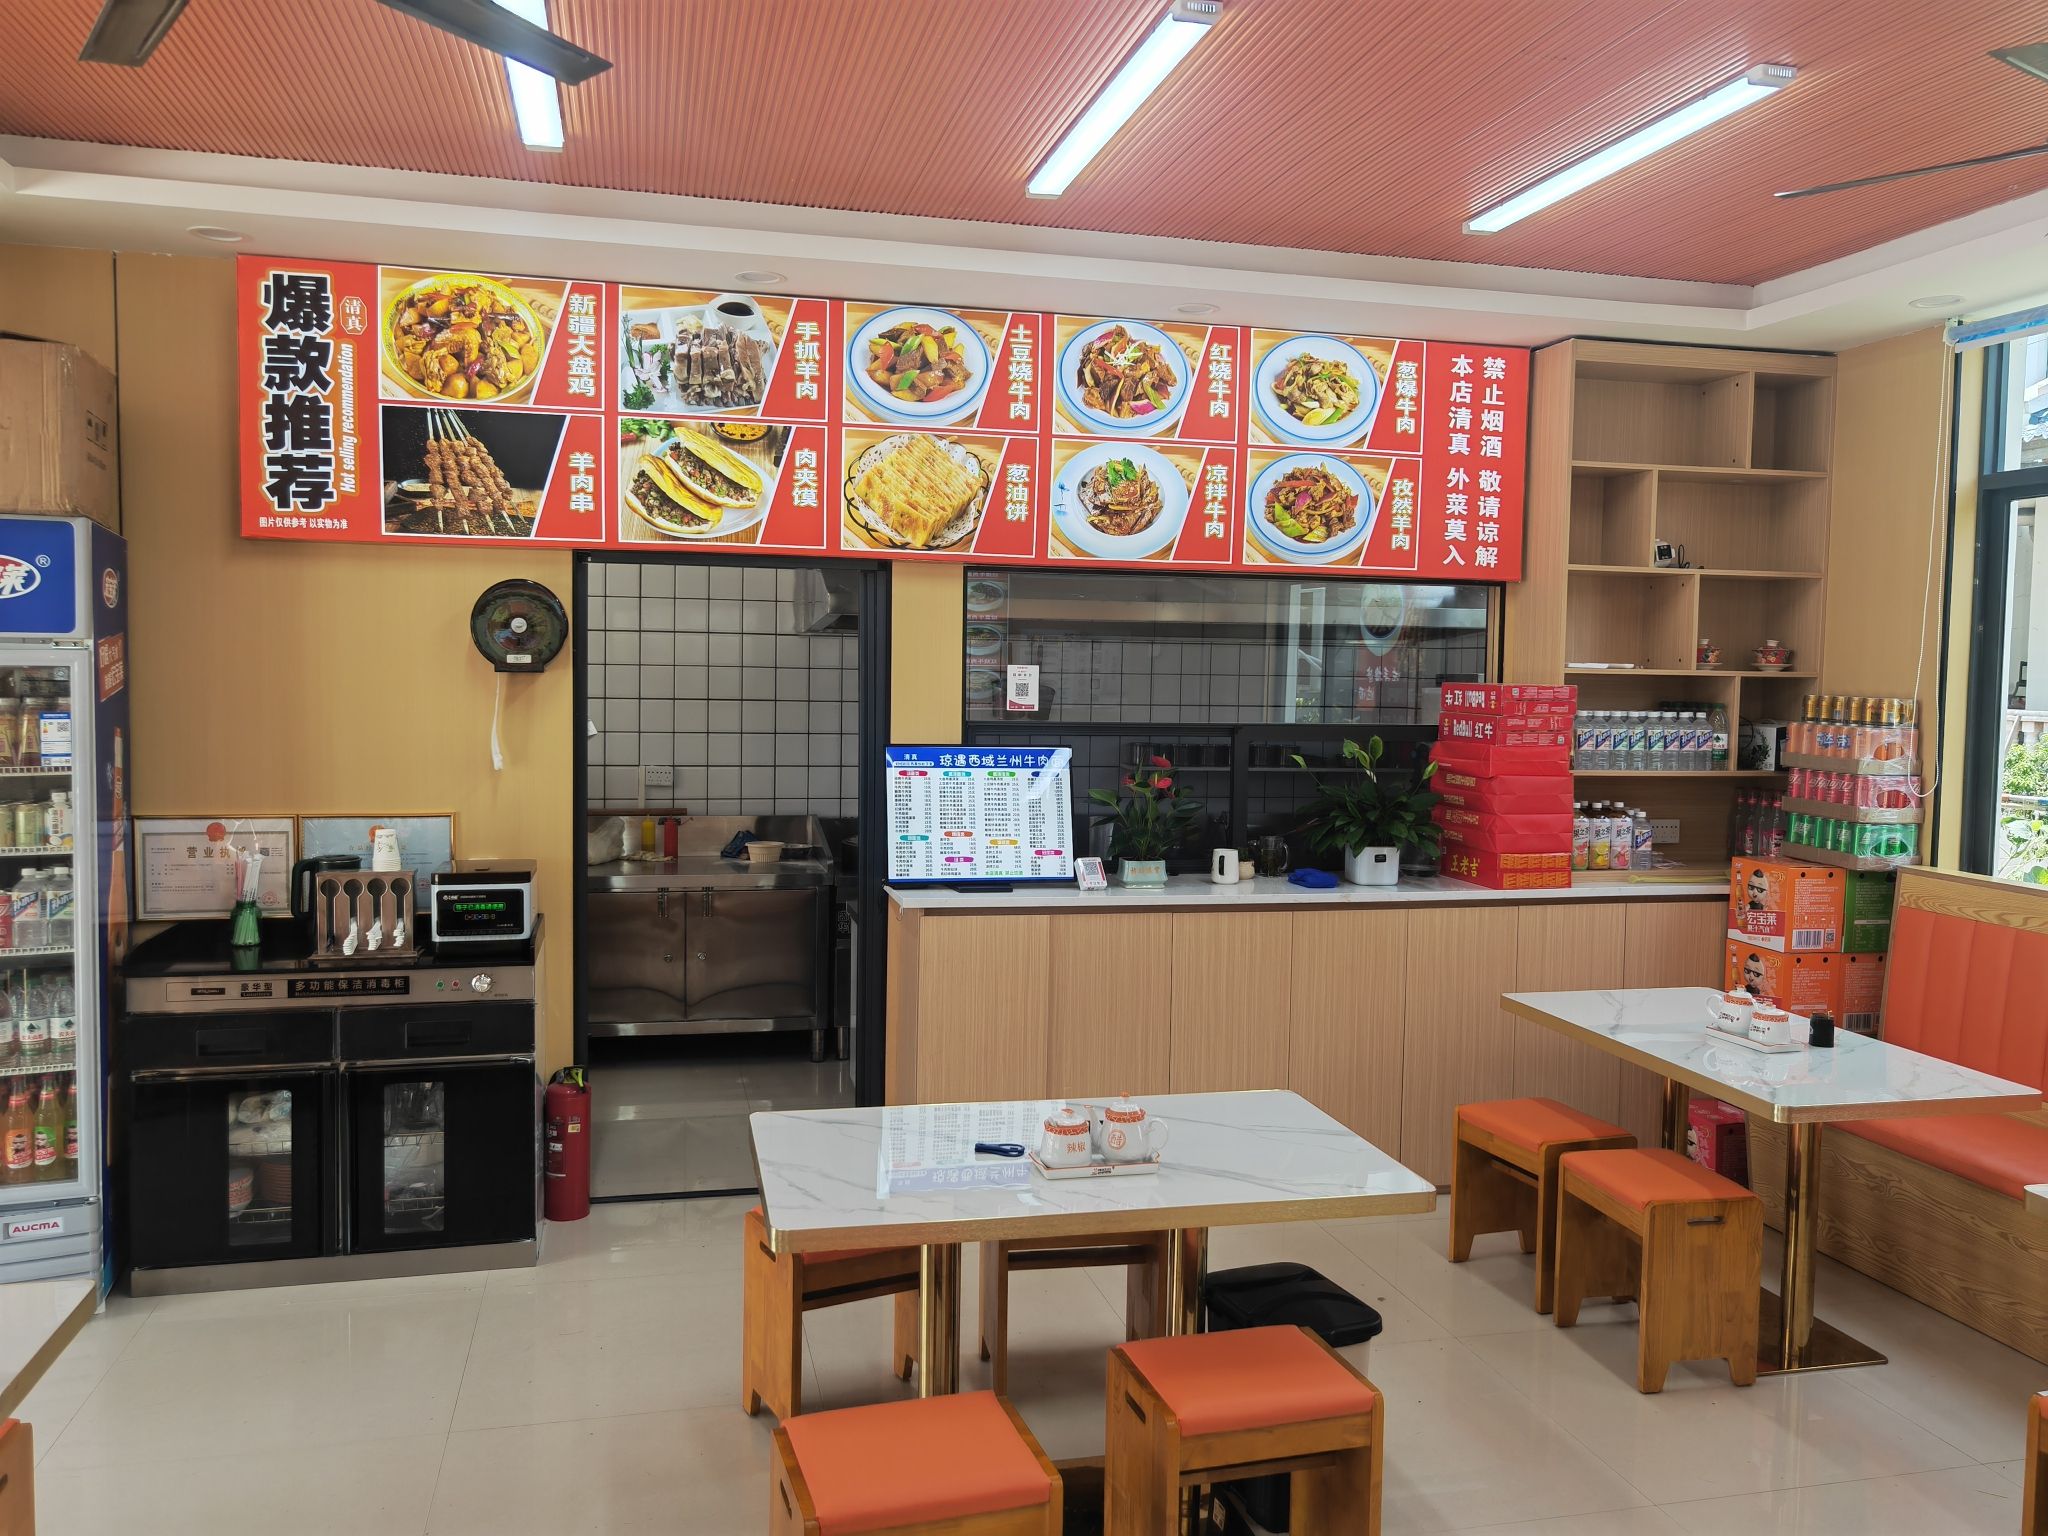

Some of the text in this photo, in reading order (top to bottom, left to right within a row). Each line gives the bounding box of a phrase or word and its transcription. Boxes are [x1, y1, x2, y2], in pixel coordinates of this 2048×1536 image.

[345, 299, 363, 331] 清真
[568, 294, 596, 397] 新疆大盘鸡
[262, 271, 336, 512] 爆款推荐
[793, 322, 821, 400] 手抓羊肉
[1008, 324, 1034, 420] 土豆烧牛肉
[1208, 343, 1233, 418] 红烧牛肉
[338, 344, 358, 493] Hot selling recommendation
[1393, 361, 1418, 434] 葱爆牛肉
[568, 452, 595, 512] 羊肉串
[792, 449, 819, 508] 肉夹馍
[1004, 464, 1030, 521] 葱油饼
[1443, 354, 1474, 567] 本店清真 外菜莫入
[1475, 357, 1506, 569] 禁止烟酒 敬请谅解
[259, 516, 348, 529] 图片仅供参考 以实物为准
[1203, 464, 1229, 538] 凉拌牛肉
[1390, 479, 1413, 551] 孜然羊肉
[1450, 854, 1479, 877] 王老吉
[1747, 912, 1777, 925] 宏宝莱
[295, 979, 406, 992] 多功能保洁消毒柜
[12, 1221, 60, 1233] AUCMA
